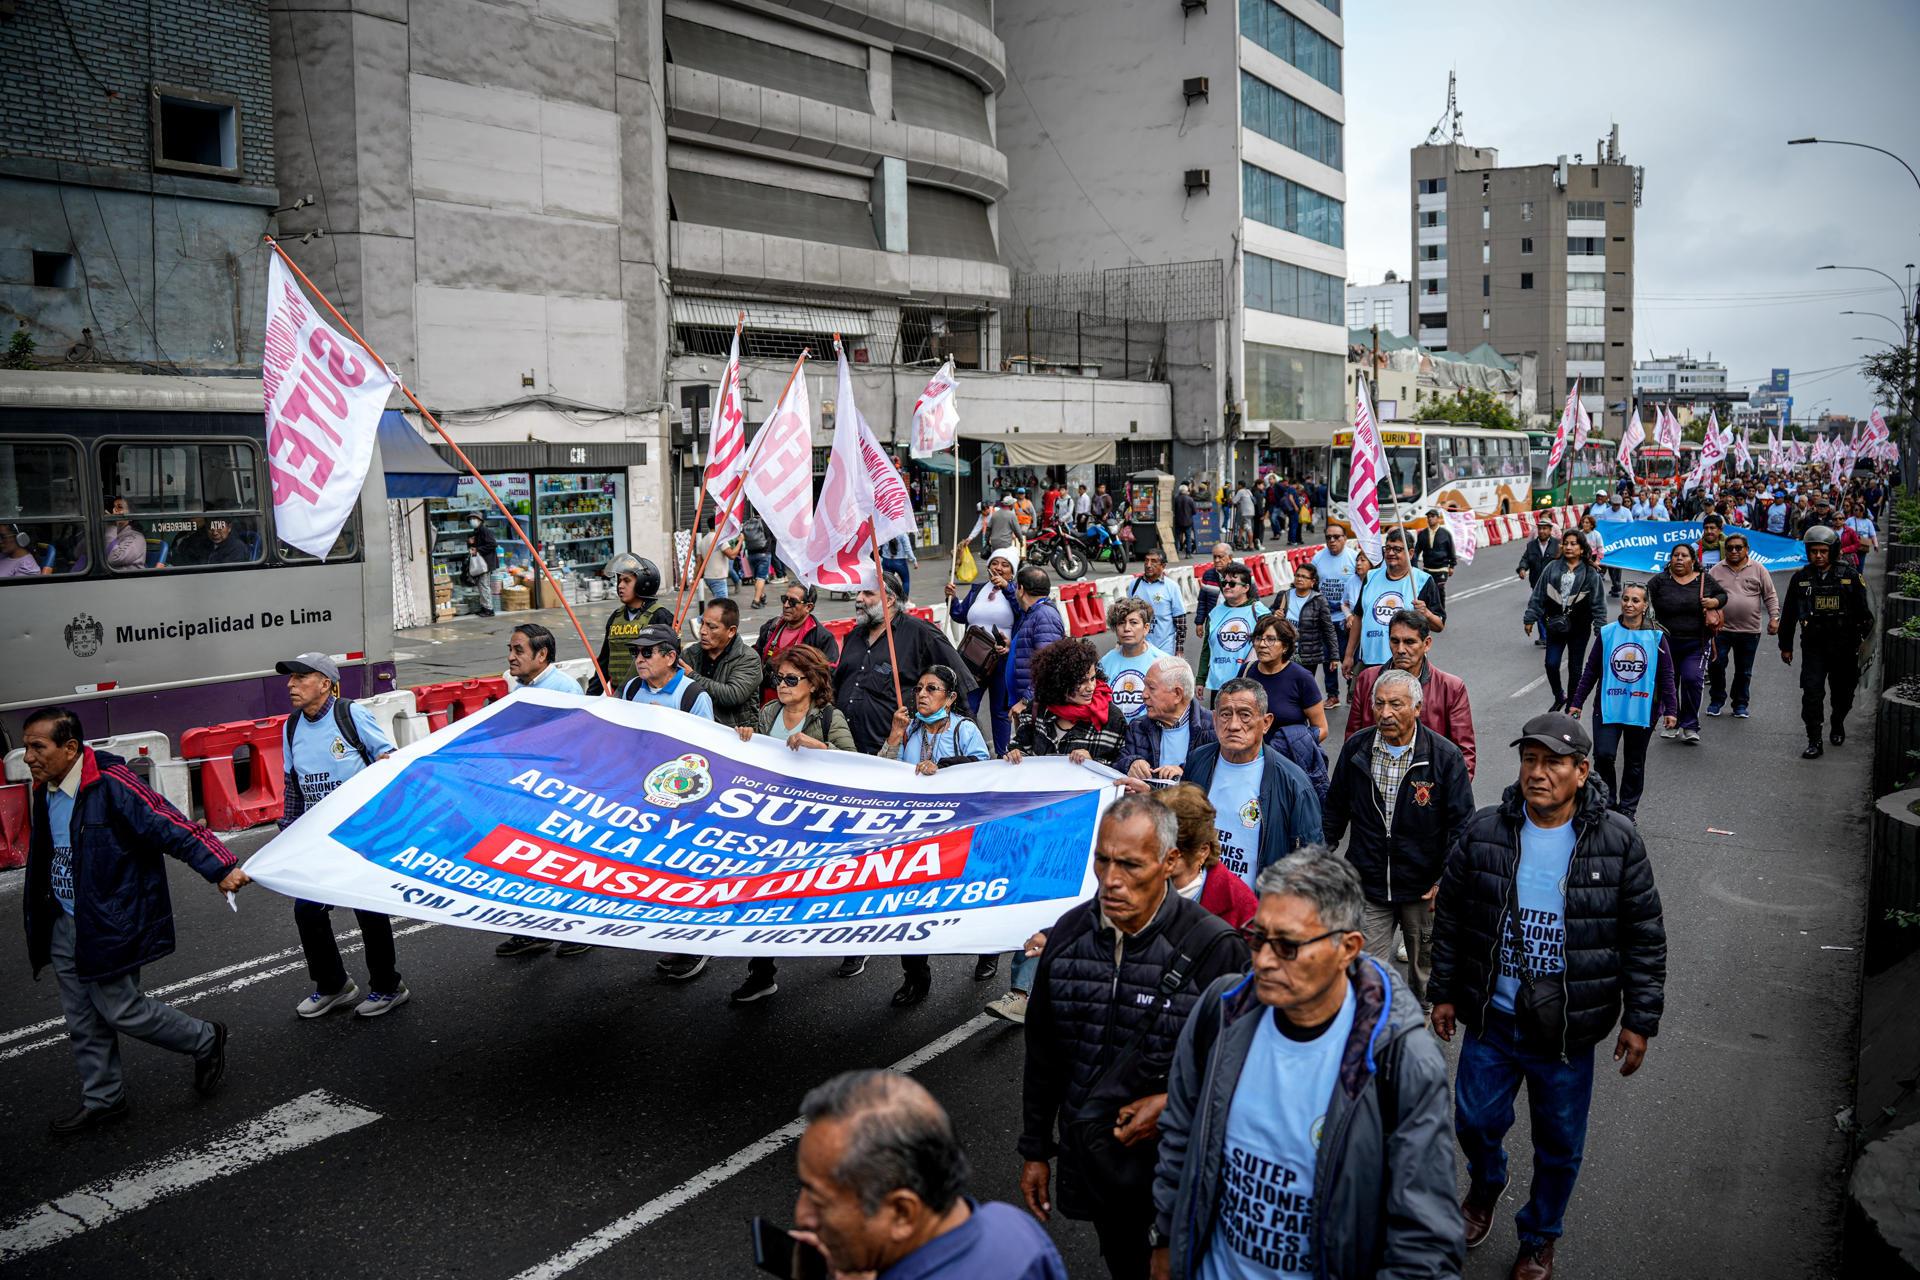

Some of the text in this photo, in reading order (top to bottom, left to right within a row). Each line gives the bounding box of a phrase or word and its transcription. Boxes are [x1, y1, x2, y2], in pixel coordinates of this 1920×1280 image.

[1381, 433, 1407, 443] LURIN
[1663, 529, 1703, 543] CESAN
[1816, 597, 1839, 608] POLICIA
[116, 607, 333, 643] Municipalidad De Lima
[610, 624, 639, 636] POLICIA
[301, 780, 342, 793] ENSIONES
[304, 772, 330, 783] SUTEP
[764, 783, 780, 793] la
[783, 786, 836, 802] Unidad
[839, 795, 899, 808] Sindical
[902, 800, 961, 809] Clasista
[508, 768, 660, 834] ACTIVOS
[667, 819, 694, 841] Y
[691, 826, 884, 859] CESANTES
[705, 787, 956, 834] SUTEP
[536, 809, 594, 844] EN
[591, 831, 642, 858] LA
[643, 844, 768, 876] LUCHA
[492, 838, 941, 905] PENSIÓN DIGNA
[1219, 857, 1249, 874] ARA
[389, 846, 567, 907] APROBACIÓN
[567, 895, 736, 924] INMEDIATA
[735, 905, 794, 924] DEL
[587, 922, 646, 938] NO
[648, 927, 735, 943] HAY
[1501, 949, 1559, 970] SANTES
[1232, 1147, 1297, 1188] SUTEP
[1224, 1161, 1313, 1214] ENSIONES
[1270, 1208, 1313, 1235] PAR
[1222, 1222, 1313, 1272] BILADOS
